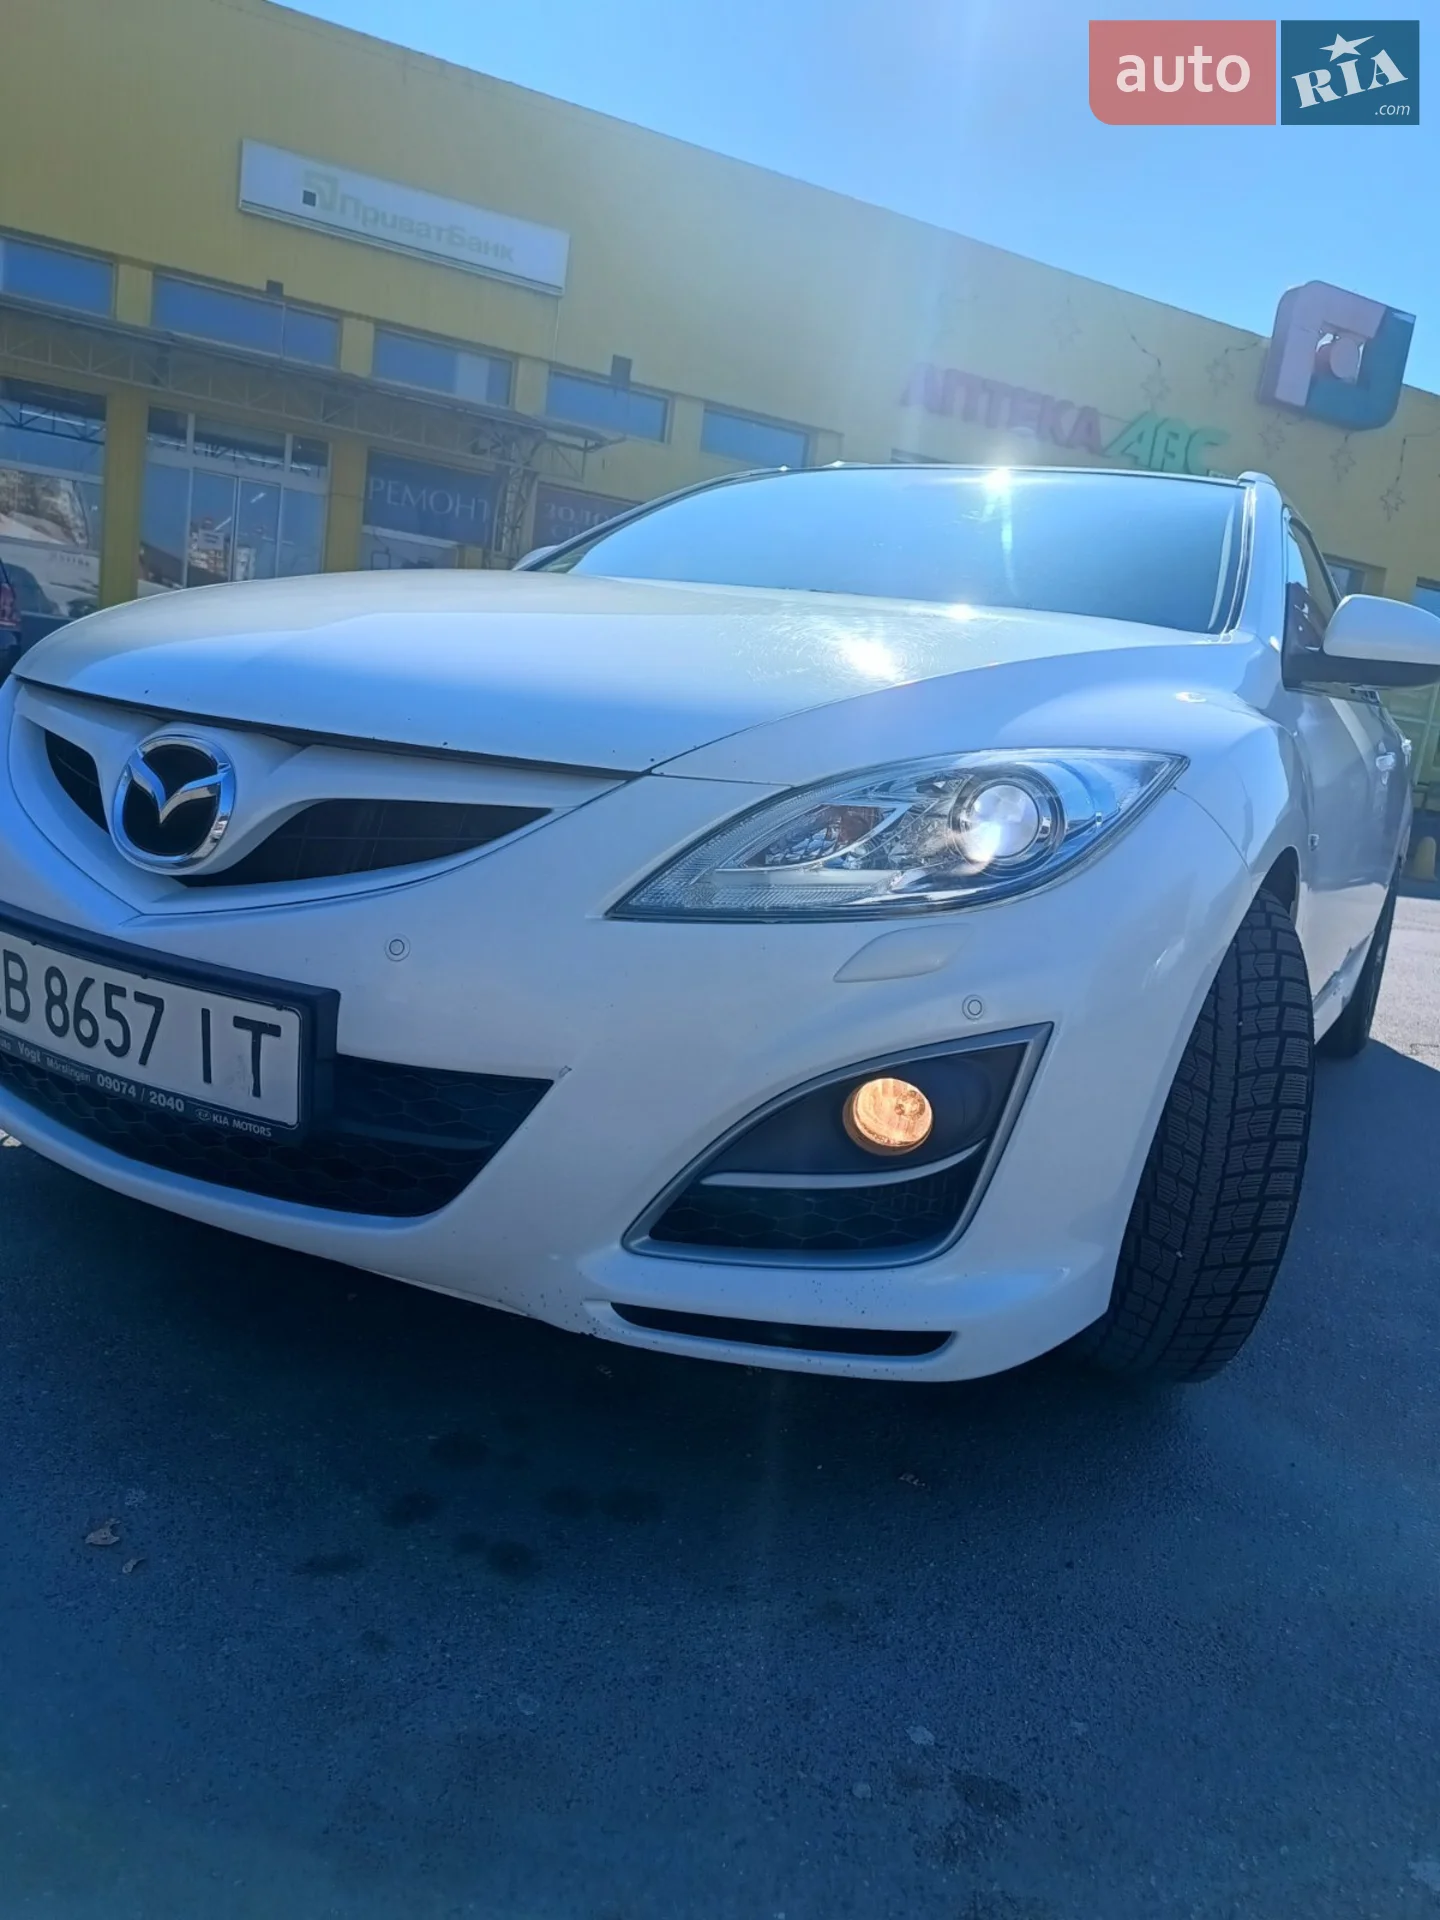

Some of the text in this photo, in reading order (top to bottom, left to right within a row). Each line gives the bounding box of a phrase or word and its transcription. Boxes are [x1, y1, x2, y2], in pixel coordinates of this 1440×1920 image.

[339, 193, 515, 263] ПриватБанк
[368, 476, 489, 523] РЕМОНТ
[0, 949, 281, 1098] B 8657 IT
[97, 1073, 136, 1098] 09074
[149, 1090, 185, 1113] 2040
[212, 1113, 229, 1126] KIA
[232, 1118, 272, 1137] MOTORS
